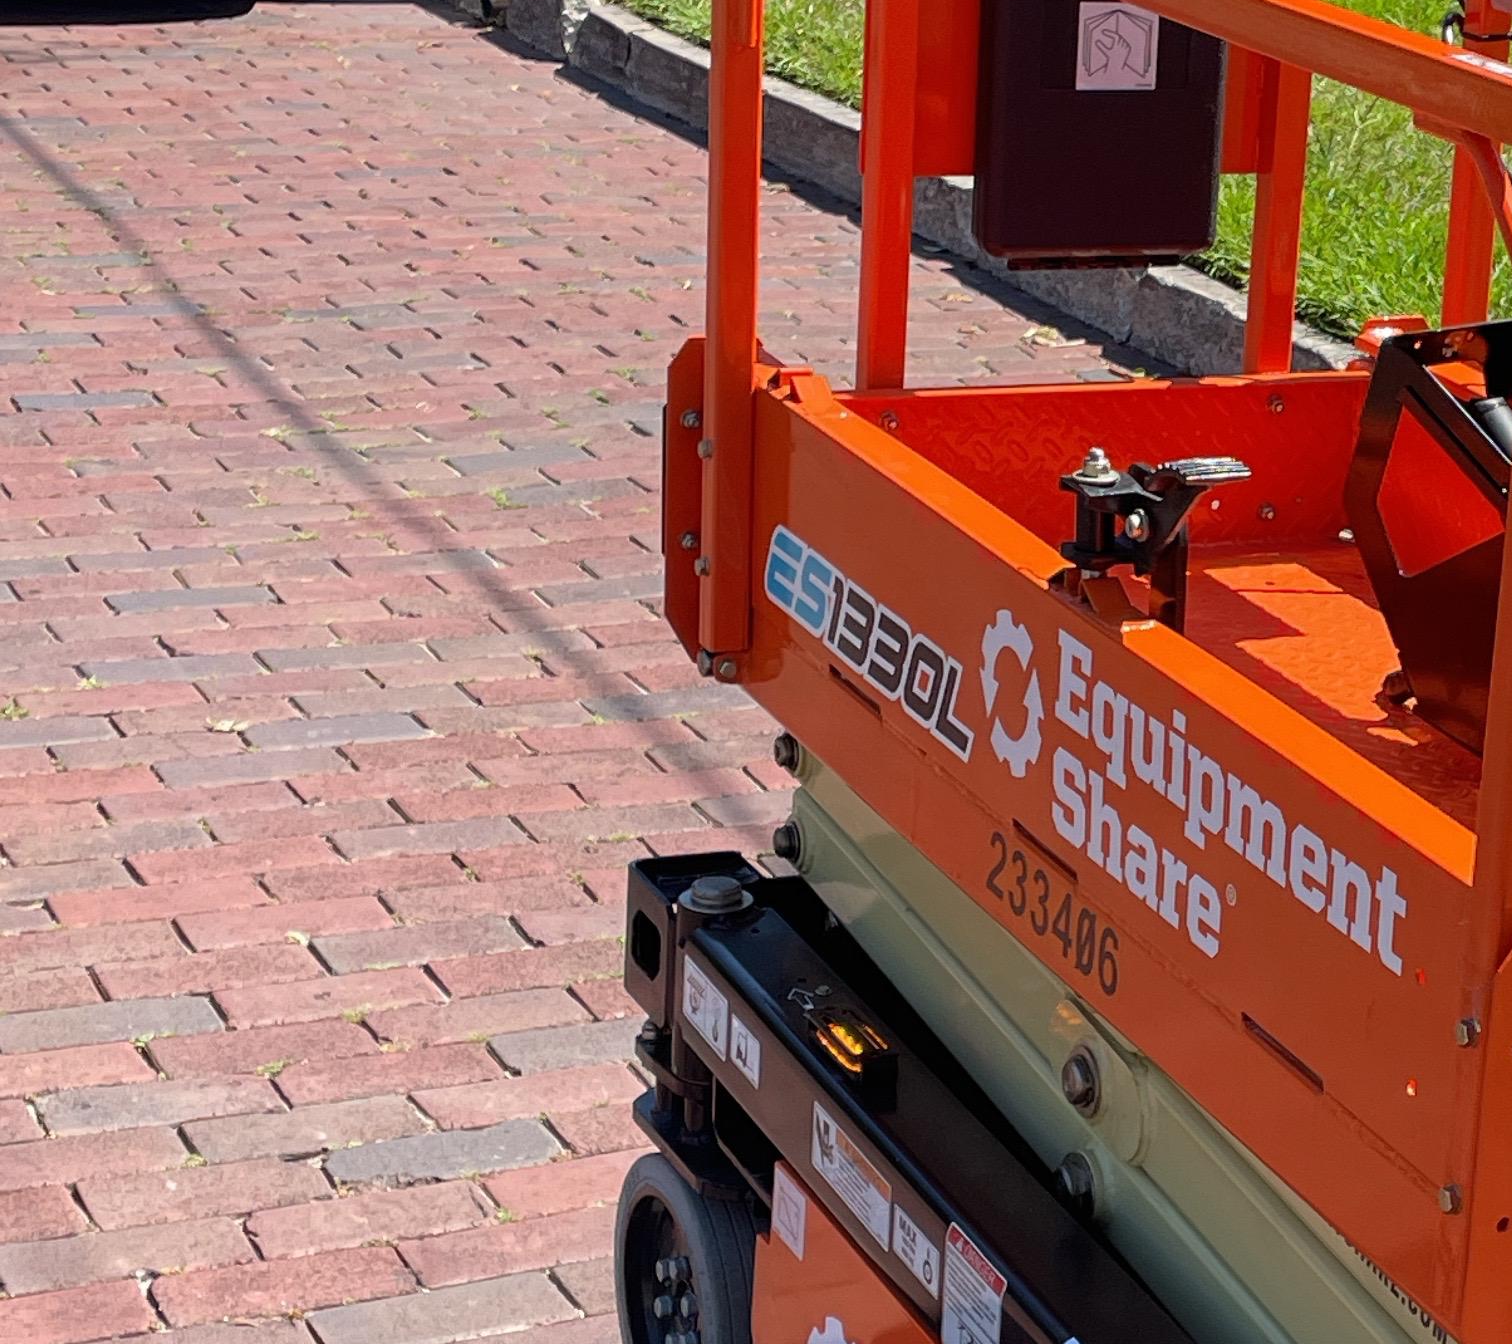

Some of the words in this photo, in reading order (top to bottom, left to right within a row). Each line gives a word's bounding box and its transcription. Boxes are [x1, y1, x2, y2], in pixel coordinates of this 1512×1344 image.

[764, 524, 975, 763] ES1330L
[986, 831, 1120, 996] 233406
[1055, 628, 1407, 976] Equipment
